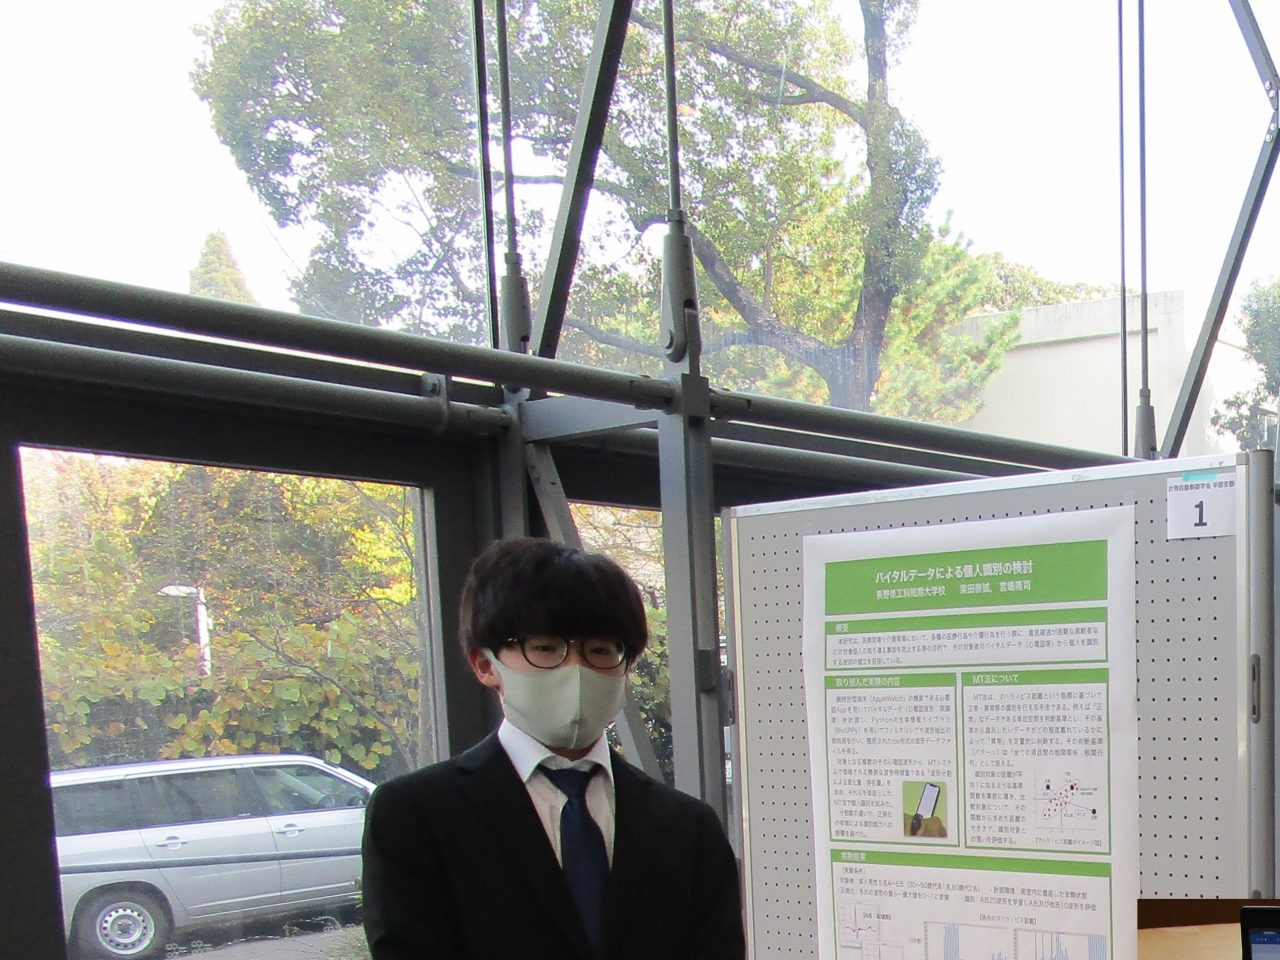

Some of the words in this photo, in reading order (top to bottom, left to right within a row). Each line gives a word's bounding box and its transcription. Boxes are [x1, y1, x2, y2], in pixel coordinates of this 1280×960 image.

[1194, 500, 1207, 527] 1
[876, 560, 1033, 583] バイタルデータによる個人識別の検討
